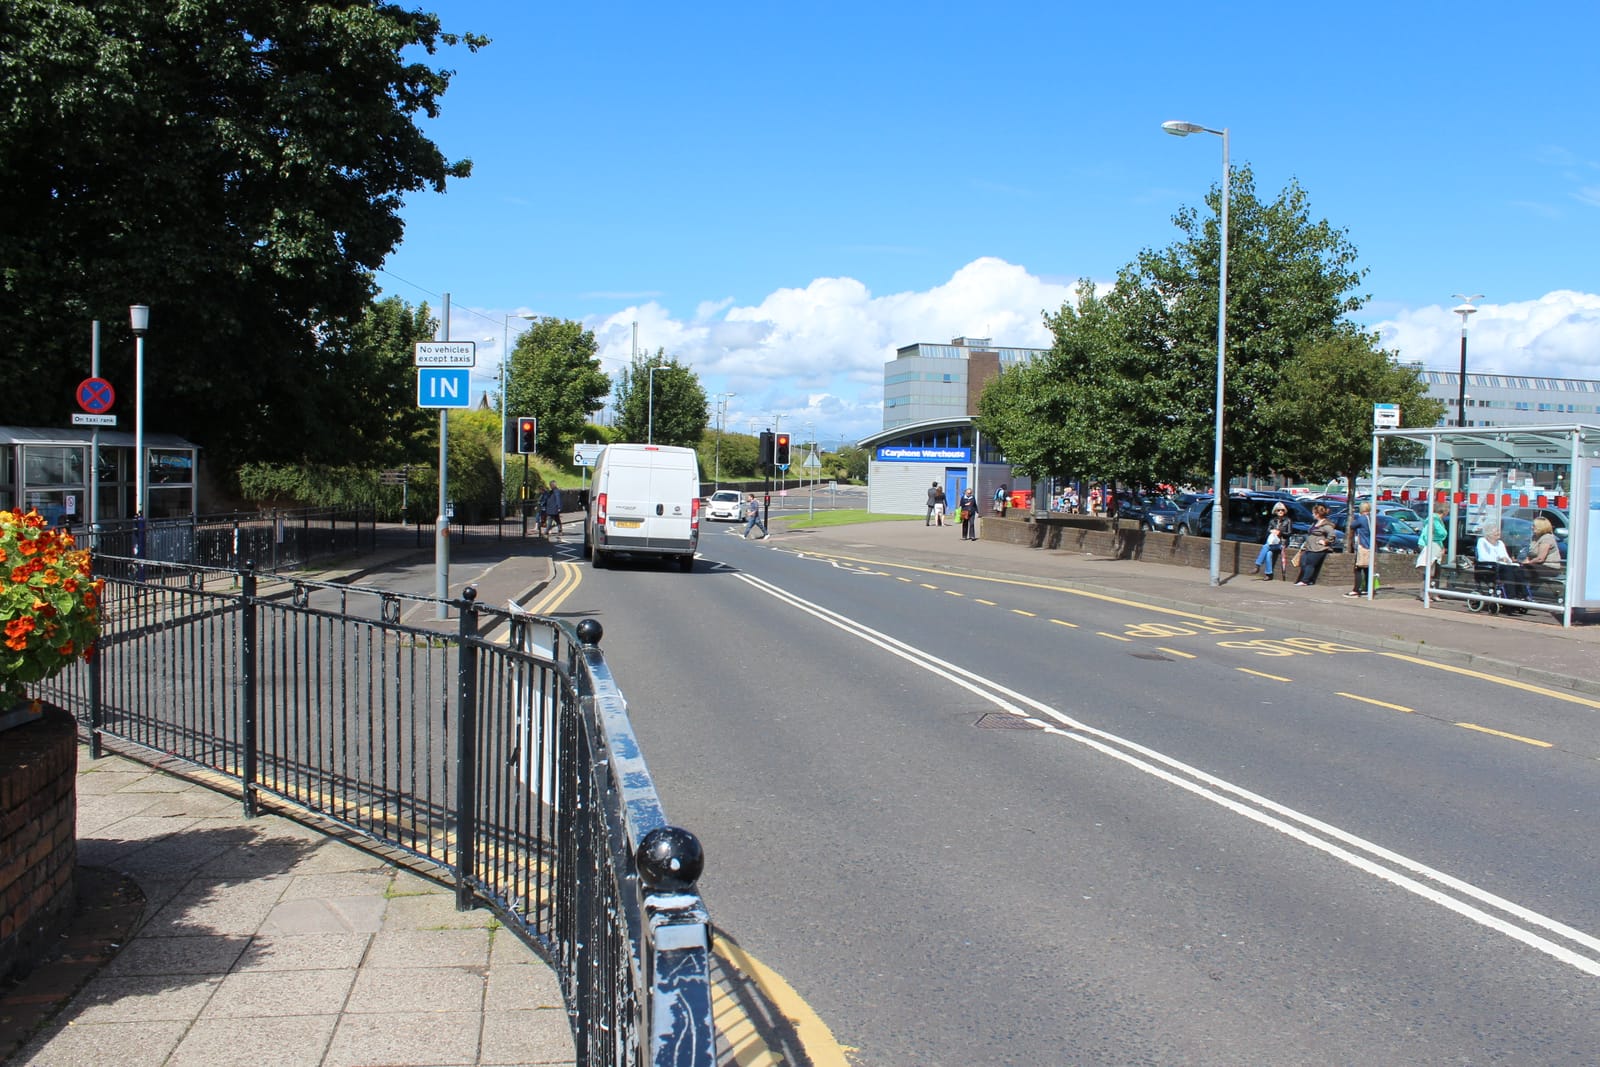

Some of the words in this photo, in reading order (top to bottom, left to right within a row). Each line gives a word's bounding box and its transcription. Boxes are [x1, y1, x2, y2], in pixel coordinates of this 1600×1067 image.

[431, 377, 458, 398] IN
[885, 449, 920, 458] Carphone
[922, 450, 965, 458] Warehouse
[1124, 620, 1265, 638] STOP
[1216, 637, 1377, 657] BUS
